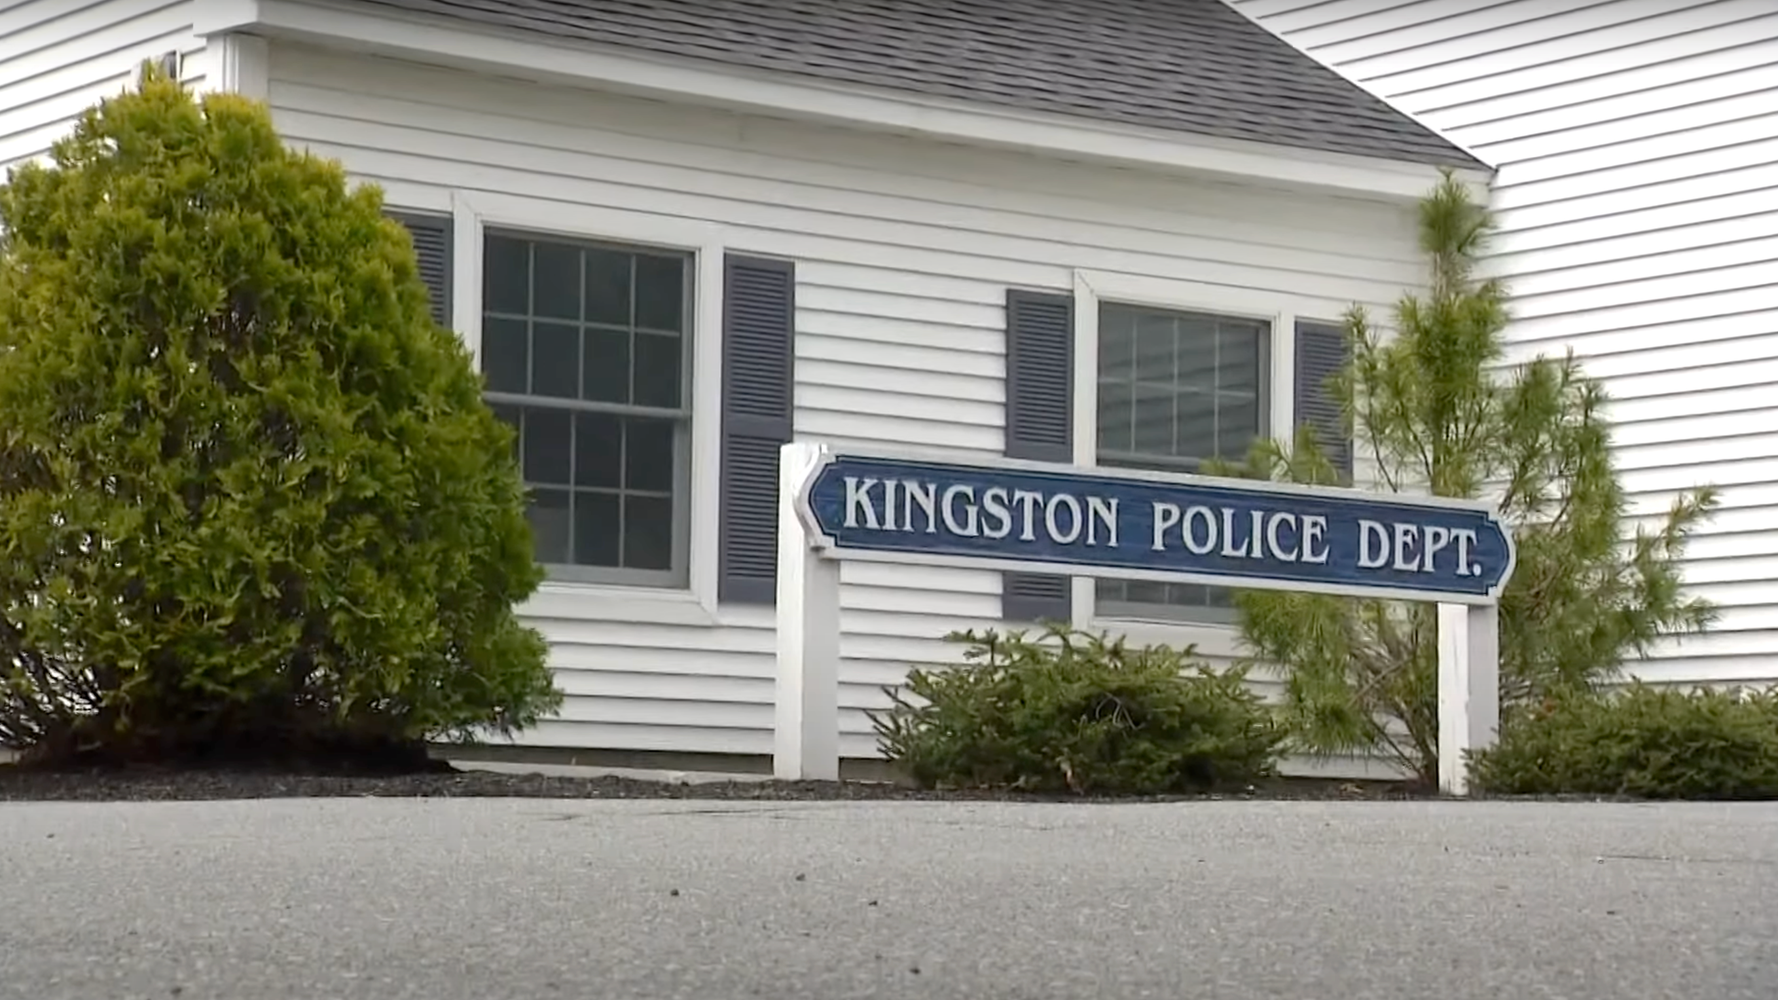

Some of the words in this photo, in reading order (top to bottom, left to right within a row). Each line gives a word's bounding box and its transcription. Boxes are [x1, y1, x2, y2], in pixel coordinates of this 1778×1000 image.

[842, 475, 1119, 551] KINGSTON
[1151, 501, 1330, 565] POLICE
[1357, 518, 1483, 578] DEPT.
